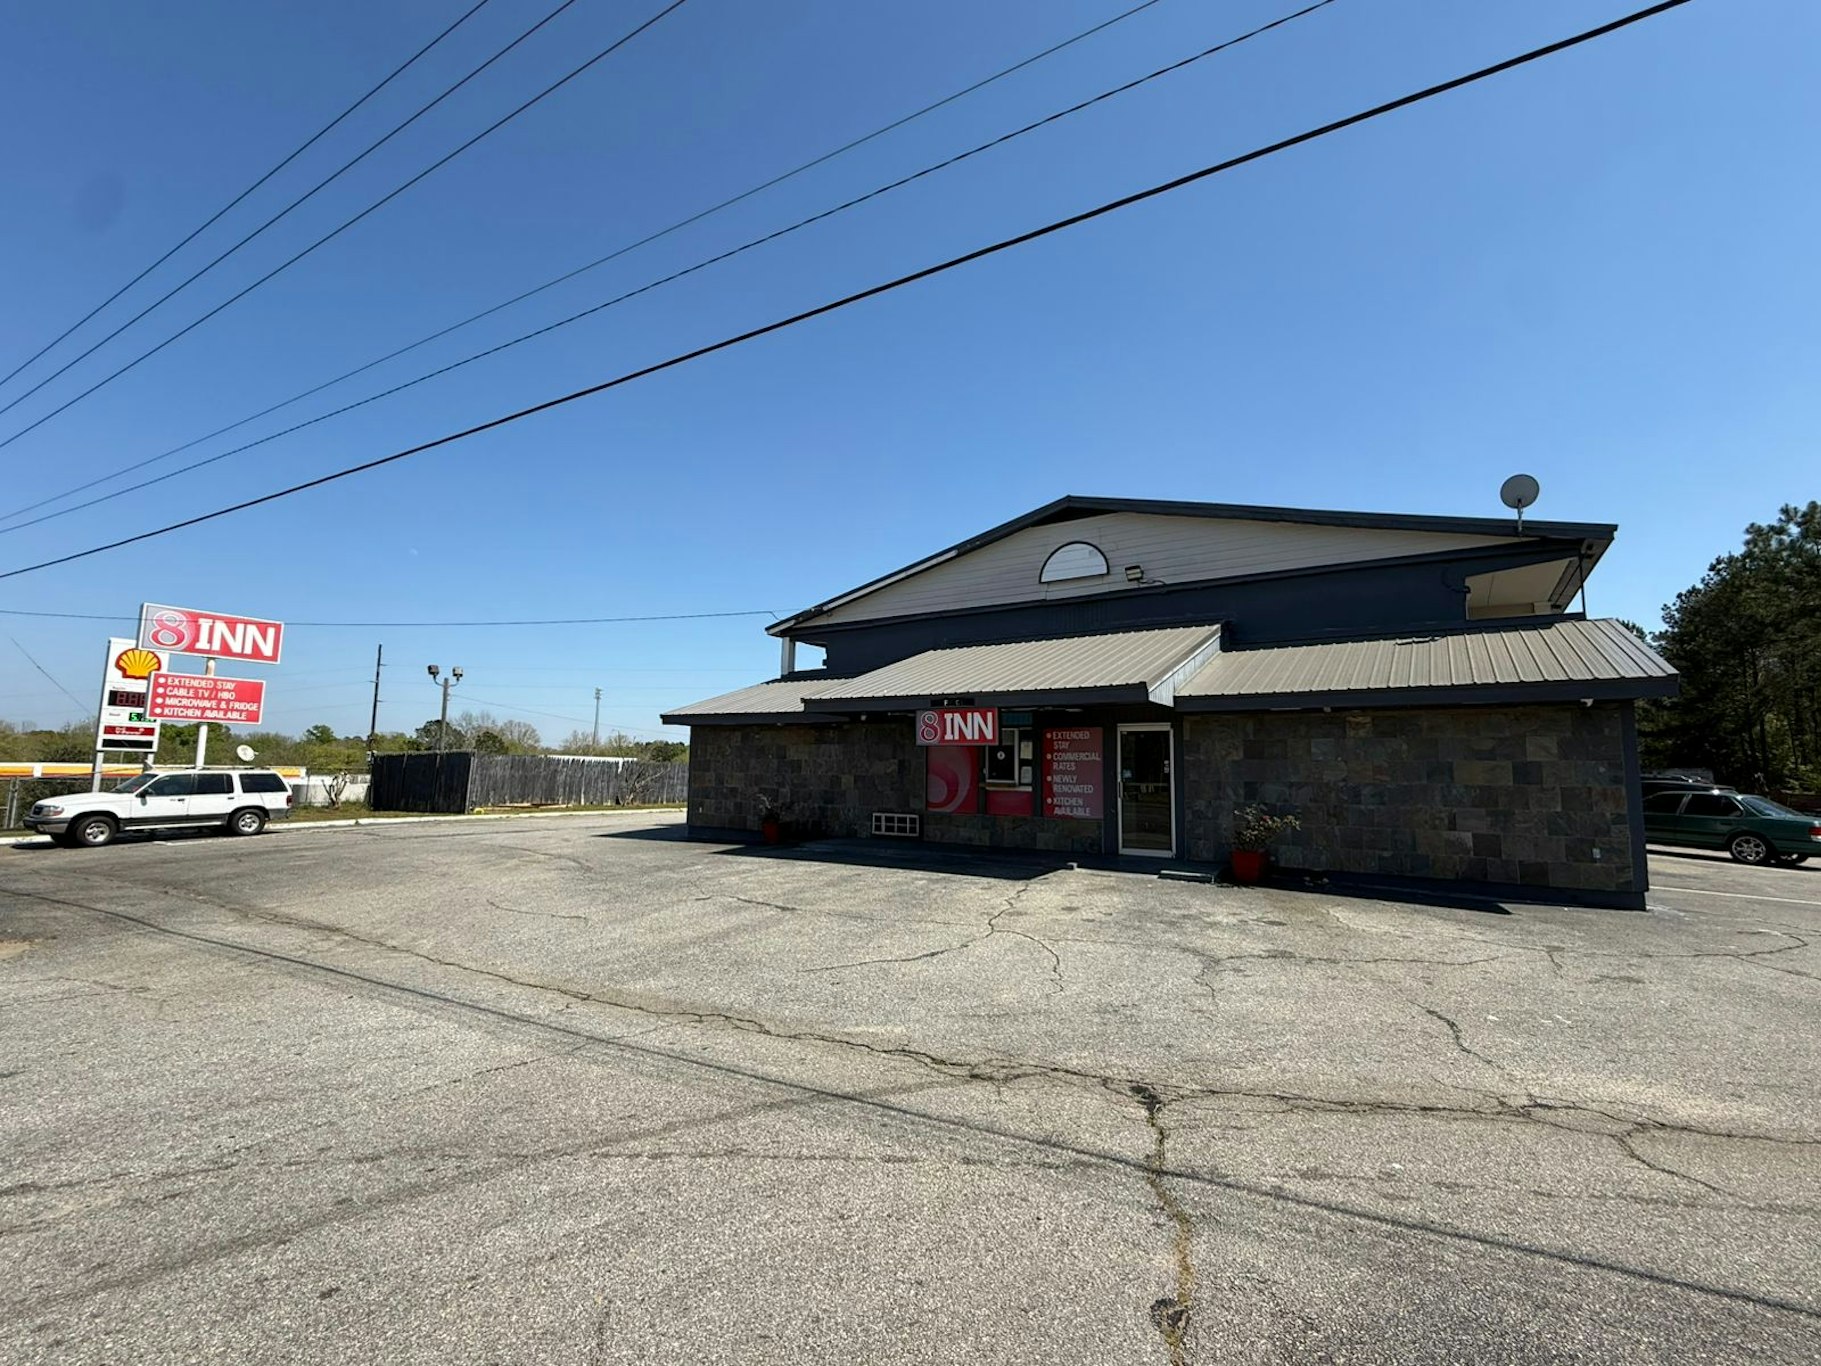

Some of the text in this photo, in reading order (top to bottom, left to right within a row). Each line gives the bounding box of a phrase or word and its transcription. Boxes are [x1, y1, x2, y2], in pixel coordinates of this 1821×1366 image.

[149, 610, 276, 657] 8 INN
[167, 676, 236, 690] EXTENDED STAY
[166, 686, 194, 697] CABLE
[198, 689, 210, 698] TV
[218, 691, 236, 700] HBO
[164, 697, 259, 711] MICROWAVE & FRIDGE
[163, 707, 247, 720] KITCHEN AVAILABLE
[920, 710, 993, 743] 8 INN
[1052, 731, 1090, 740] EXTENDED
[1053, 741, 1070, 750] STAY
[1052, 752, 1101, 761] COMMERCIAL
[1052, 762, 1076, 771] RATES
[1052, 774, 1078, 783] NEWLY
[1052, 784, 1094, 793] RENOVATED
[1052, 797, 1084, 806] KITCHEN
[1054, 807, 1091, 816] AVAILABLE
